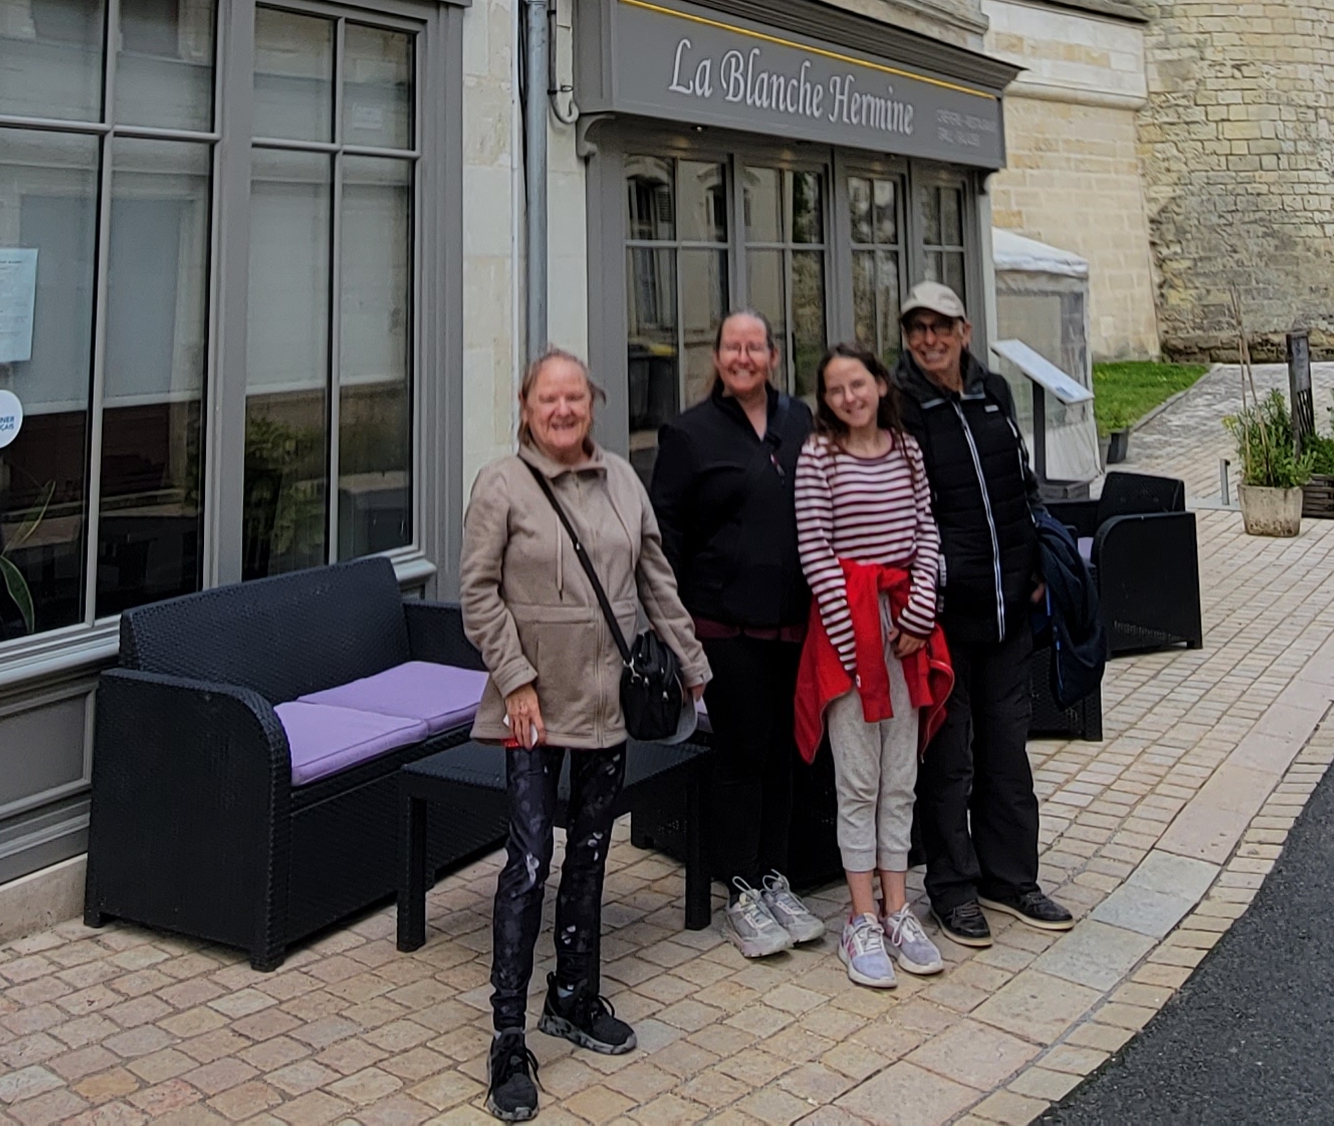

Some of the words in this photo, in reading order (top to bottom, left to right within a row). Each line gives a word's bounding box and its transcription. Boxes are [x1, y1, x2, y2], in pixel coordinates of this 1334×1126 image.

[669, 39, 712, 98] La
[720, 48, 823, 118] Blanche
[828, 74, 914, 136] Hermine
